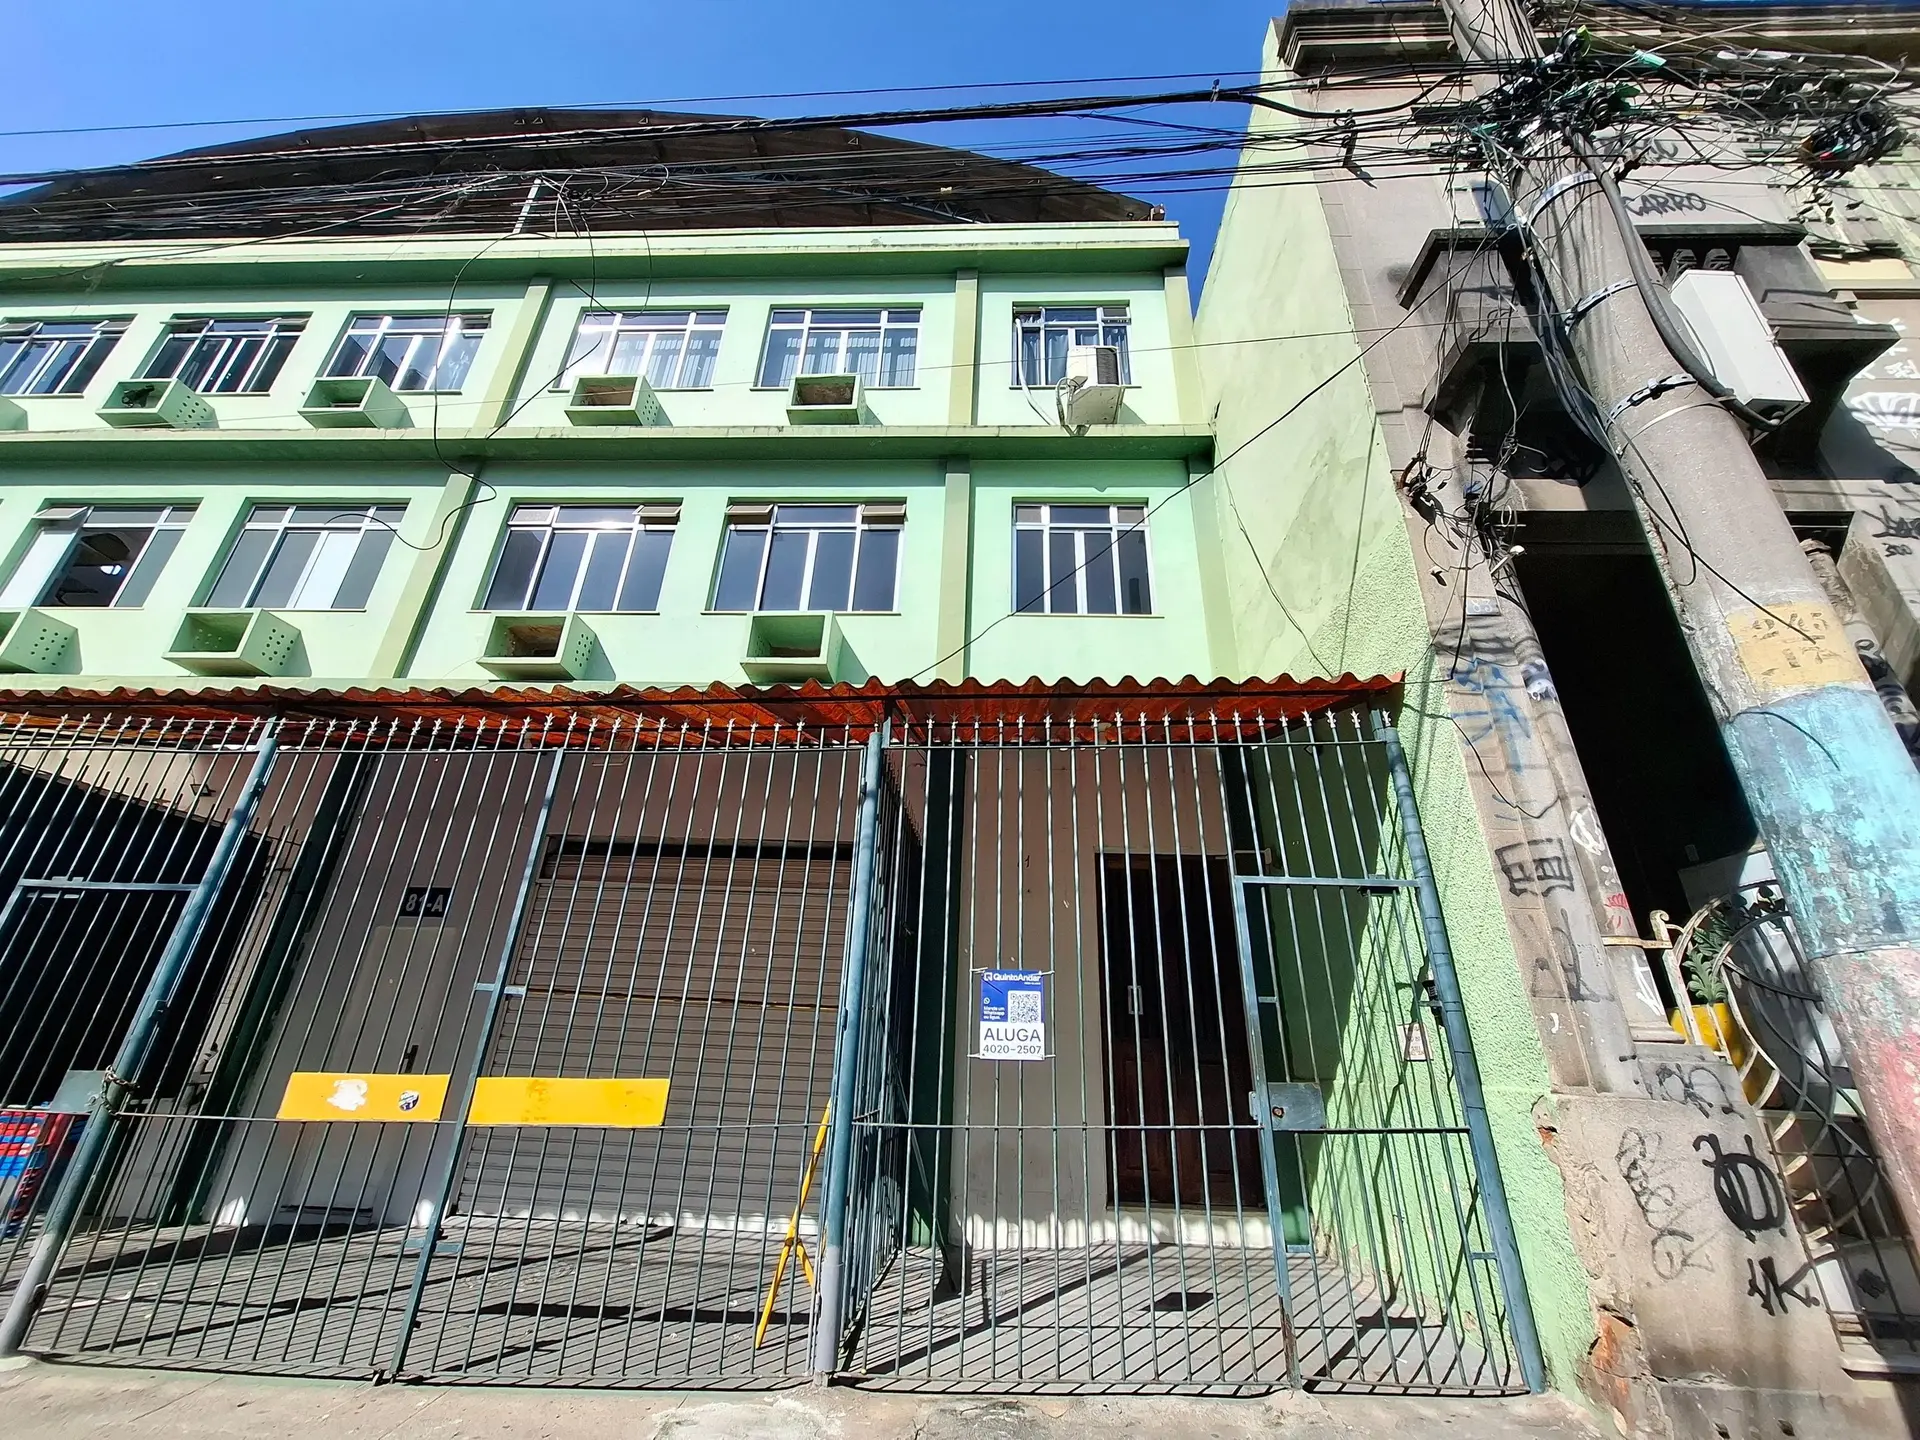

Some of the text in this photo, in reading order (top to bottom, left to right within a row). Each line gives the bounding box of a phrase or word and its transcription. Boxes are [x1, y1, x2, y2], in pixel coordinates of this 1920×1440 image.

[405, 893, 444, 912] 81-A
[993, 973, 1041, 982] QuintoAndar
[983, 1027, 1041, 1042] ALUGA
[983, 1044, 1042, 1055] 4020-2507
